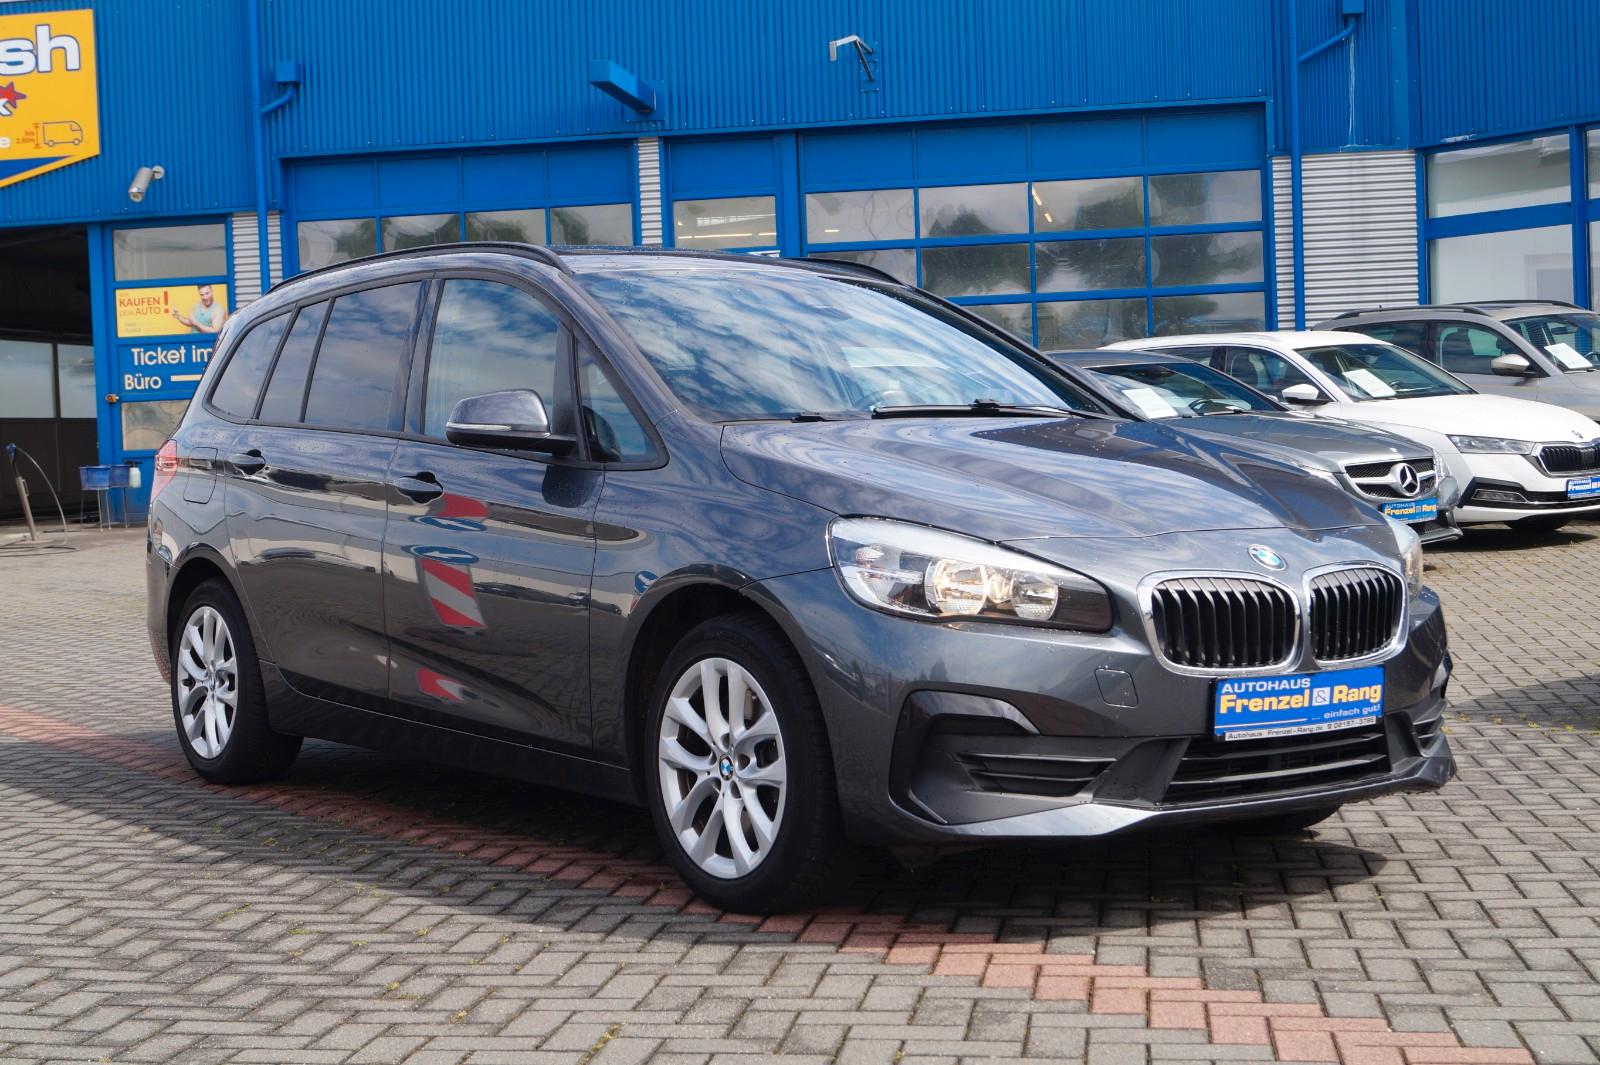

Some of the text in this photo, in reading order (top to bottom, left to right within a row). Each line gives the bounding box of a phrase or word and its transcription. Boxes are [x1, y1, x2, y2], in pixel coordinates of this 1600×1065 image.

[119, 296, 160, 307] KAUFEN
[135, 306, 161, 316] AUTO
[131, 345, 186, 366] Ticket
[124, 373, 162, 390] Büro
[1221, 678, 1311, 694] AUTOHAUS
[1219, 689, 1310, 714] Frenzel
[1332, 684, 1382, 704] Rang
[1324, 707, 1360, 720] einfach
[1362, 704, 1382, 715] gut!
